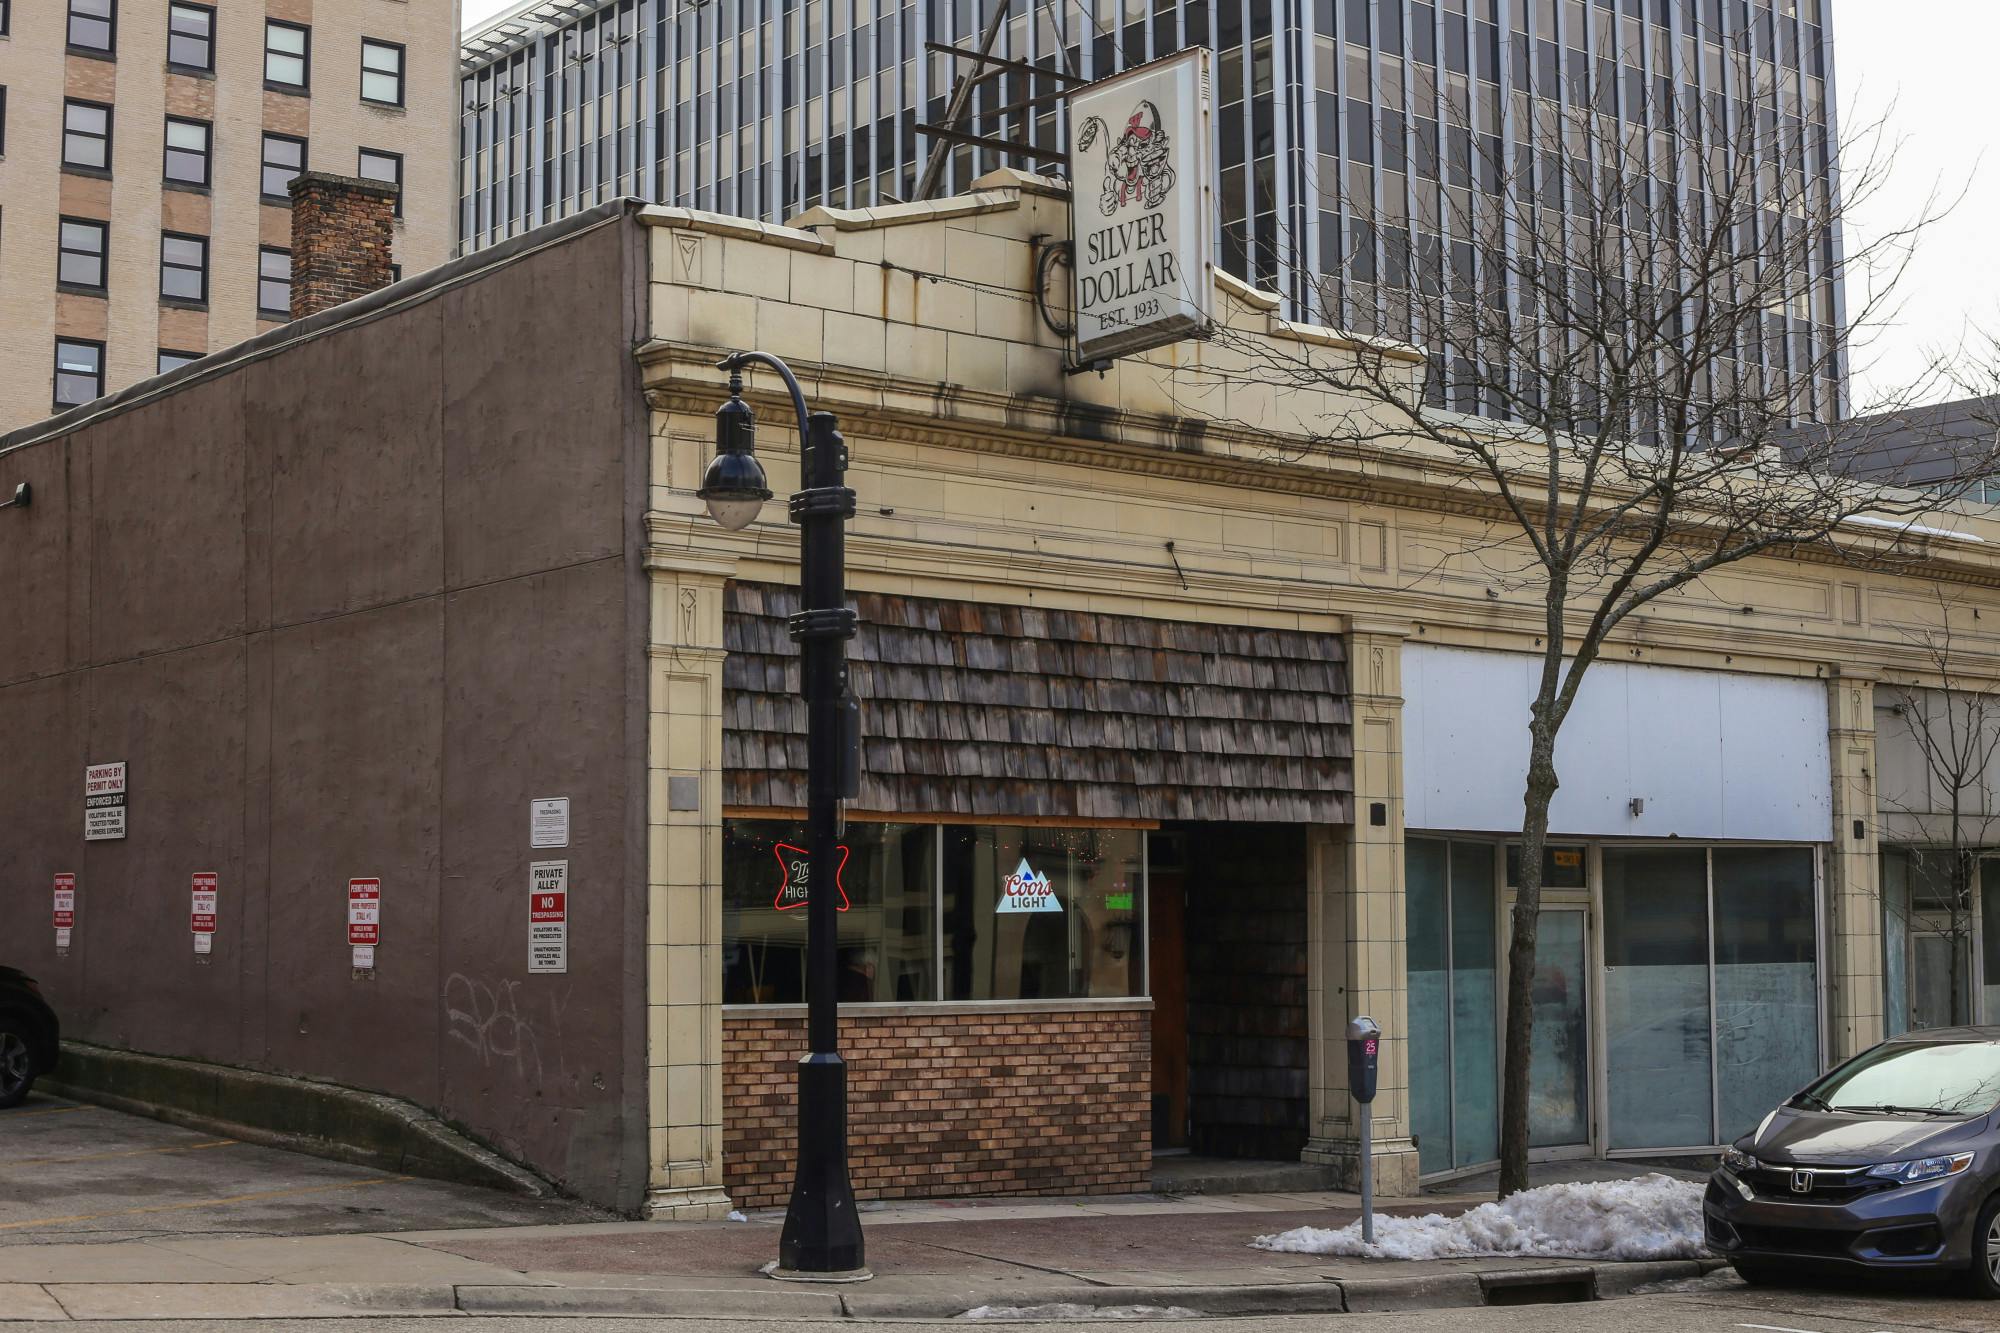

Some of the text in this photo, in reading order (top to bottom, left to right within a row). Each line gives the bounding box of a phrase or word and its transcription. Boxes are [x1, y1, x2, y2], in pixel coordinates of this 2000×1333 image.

[1087, 212, 1167, 265] SILVER
[1080, 251, 1176, 310] DOLLAR
[1099, 298, 1159, 331] EST. 1933
[88, 766, 122, 780] PARKING BY
[87, 779, 123, 792] PERMIT ONLY
[86, 796, 112, 807] ENFORCED
[88, 811, 107, 819] VIOLATORS
[534, 868, 563, 879] PRIVATE
[537, 879, 559, 890] ALLEY
[1004, 874, 1054, 897] Coors
[541, 896, 554, 909] NO
[1011, 896, 1047, 908] LIGHT
[531, 911, 564, 919] TRESPASSING
[1366, 1042, 1375, 1052] 25
